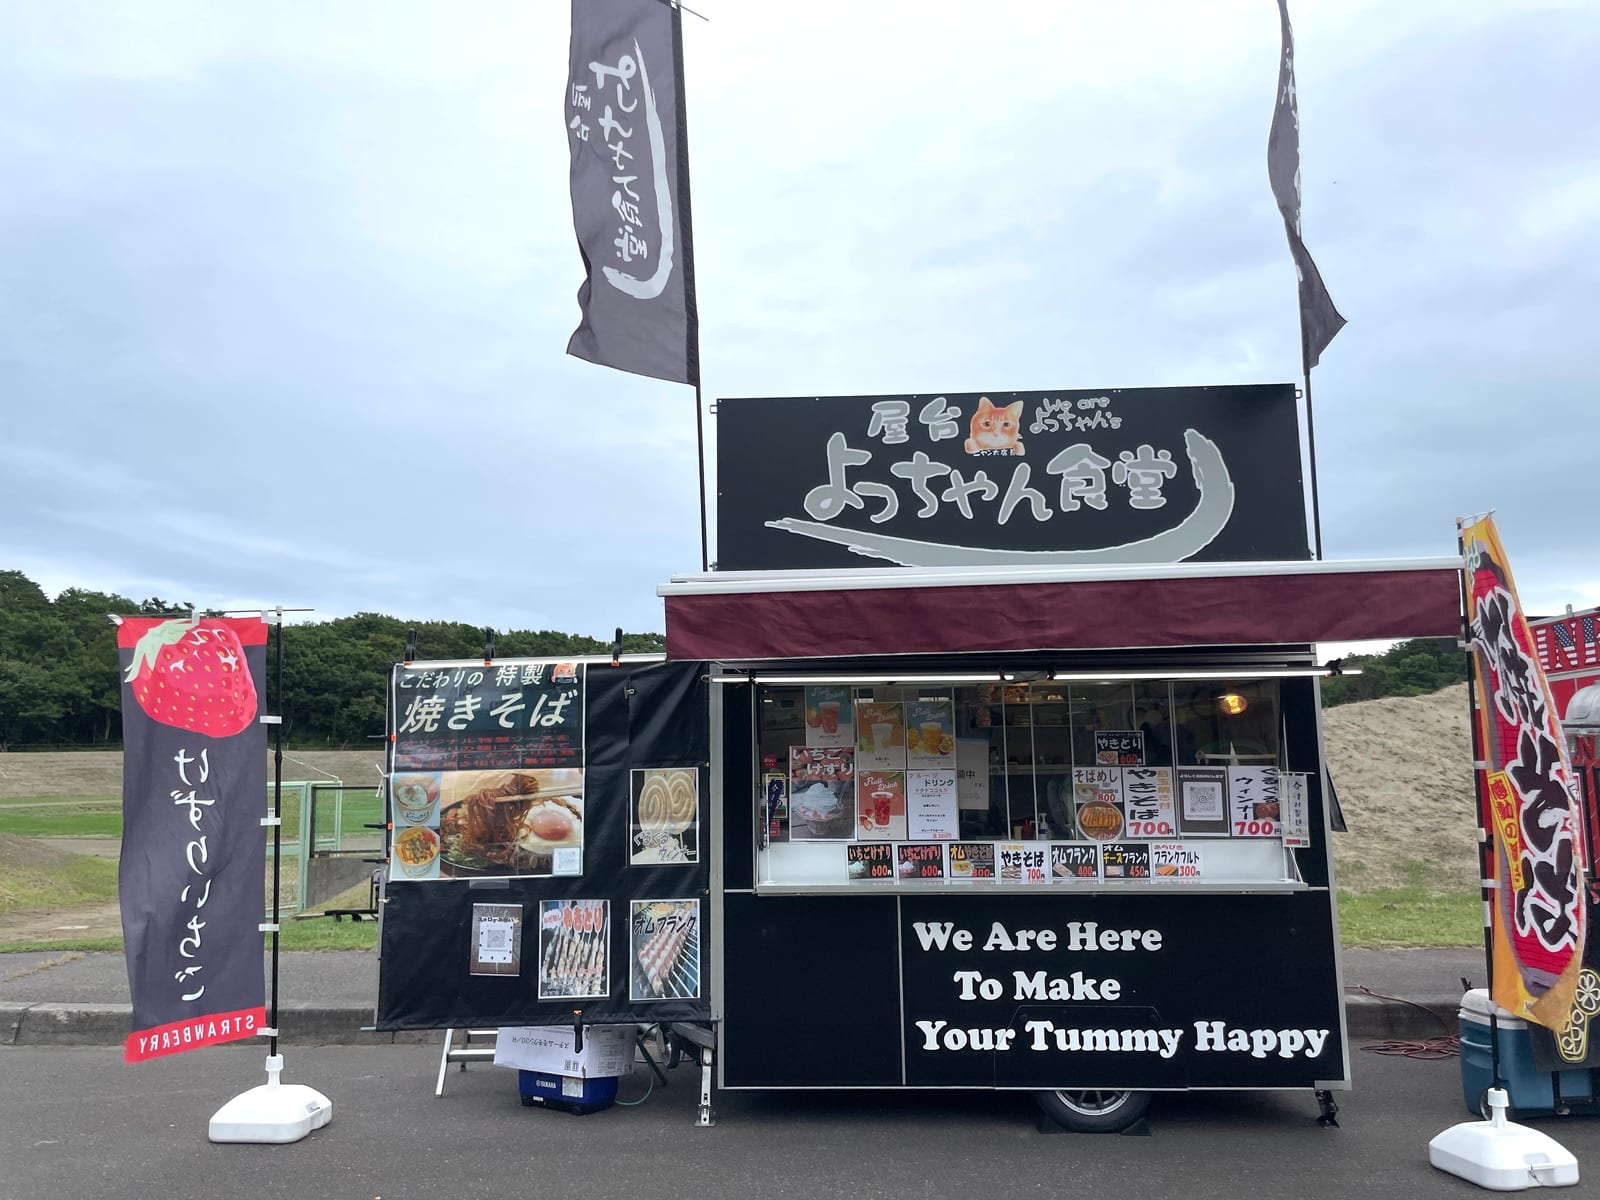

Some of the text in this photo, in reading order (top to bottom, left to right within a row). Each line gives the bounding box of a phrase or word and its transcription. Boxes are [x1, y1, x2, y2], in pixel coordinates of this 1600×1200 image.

[1043, 397, 1110, 412] We are
[867, 397, 961, 444] 屋台
[804, 432, 1177, 525] よっちゃん食堂
[399, 664, 545, 689] こだわりの 特製
[399, 689, 578, 733] 焼きそば
[1098, 738, 1141, 749] やきとり
[793, 748, 842, 761] いちご
[806, 762, 854, 777] けずり
[1075, 769, 1118, 783] そばめし
[878, 781, 898, 791] Drink
[924, 779, 954, 787] ドリンク
[1127, 769, 1159, 820] やきそば
[1235, 777, 1254, 820] ウィンナー
[1129, 821, 1175, 836] 700円
[1234, 821, 1281, 836] 700円
[849, 845, 891, 861] いちごけずり
[899, 846, 941, 861] いちごけずり
[1001, 851, 1044, 867] やきそば
[1052, 848, 1095, 864] オムフランク
[1154, 851, 1200, 864] フランクフルト
[871, 865, 892, 877] 600円
[921, 865, 942, 877] 600円
[1026, 868, 1046, 879] 700円
[1078, 866, 1097, 877] 400円
[1129, 865, 1149, 877] 450円
[1179, 865, 1201, 877] 300円
[562, 905, 603, 933] やきとり
[634, 915, 697, 934] オムフランク
[913, 922, 1163, 951] We Are Here
[953, 971, 1121, 1001] To Make
[915, 1021, 1329, 1058] Your Tummy Happy
[540, 1081, 557, 1089] YAMAHA
